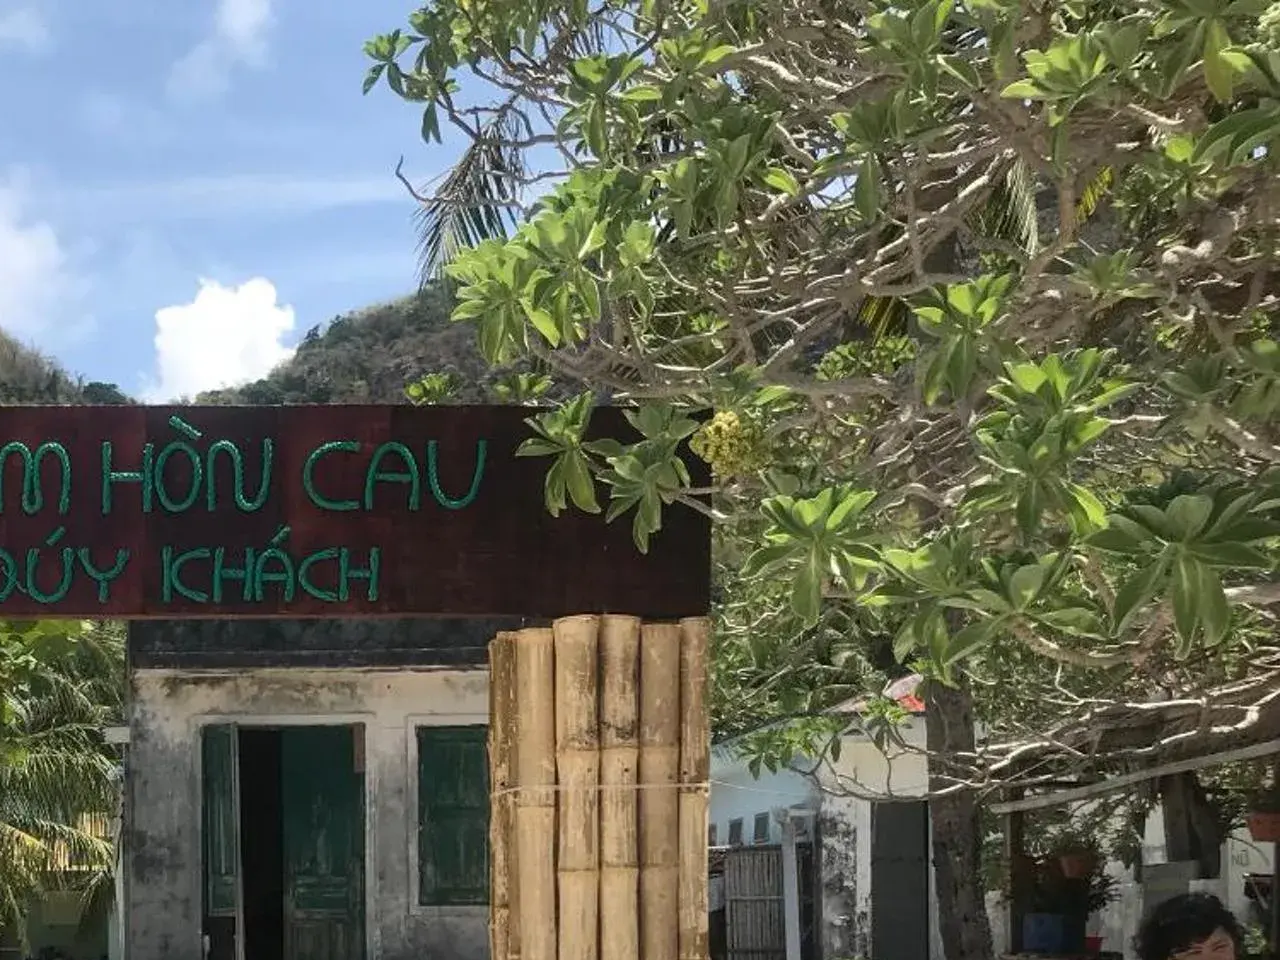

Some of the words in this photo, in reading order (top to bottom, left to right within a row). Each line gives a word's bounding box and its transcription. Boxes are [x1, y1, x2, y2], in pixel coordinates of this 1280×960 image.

[102, 415, 273, 514] HÒN
[303, 440, 487, 511] CAU
[162, 525, 379, 602] KHÁCH
